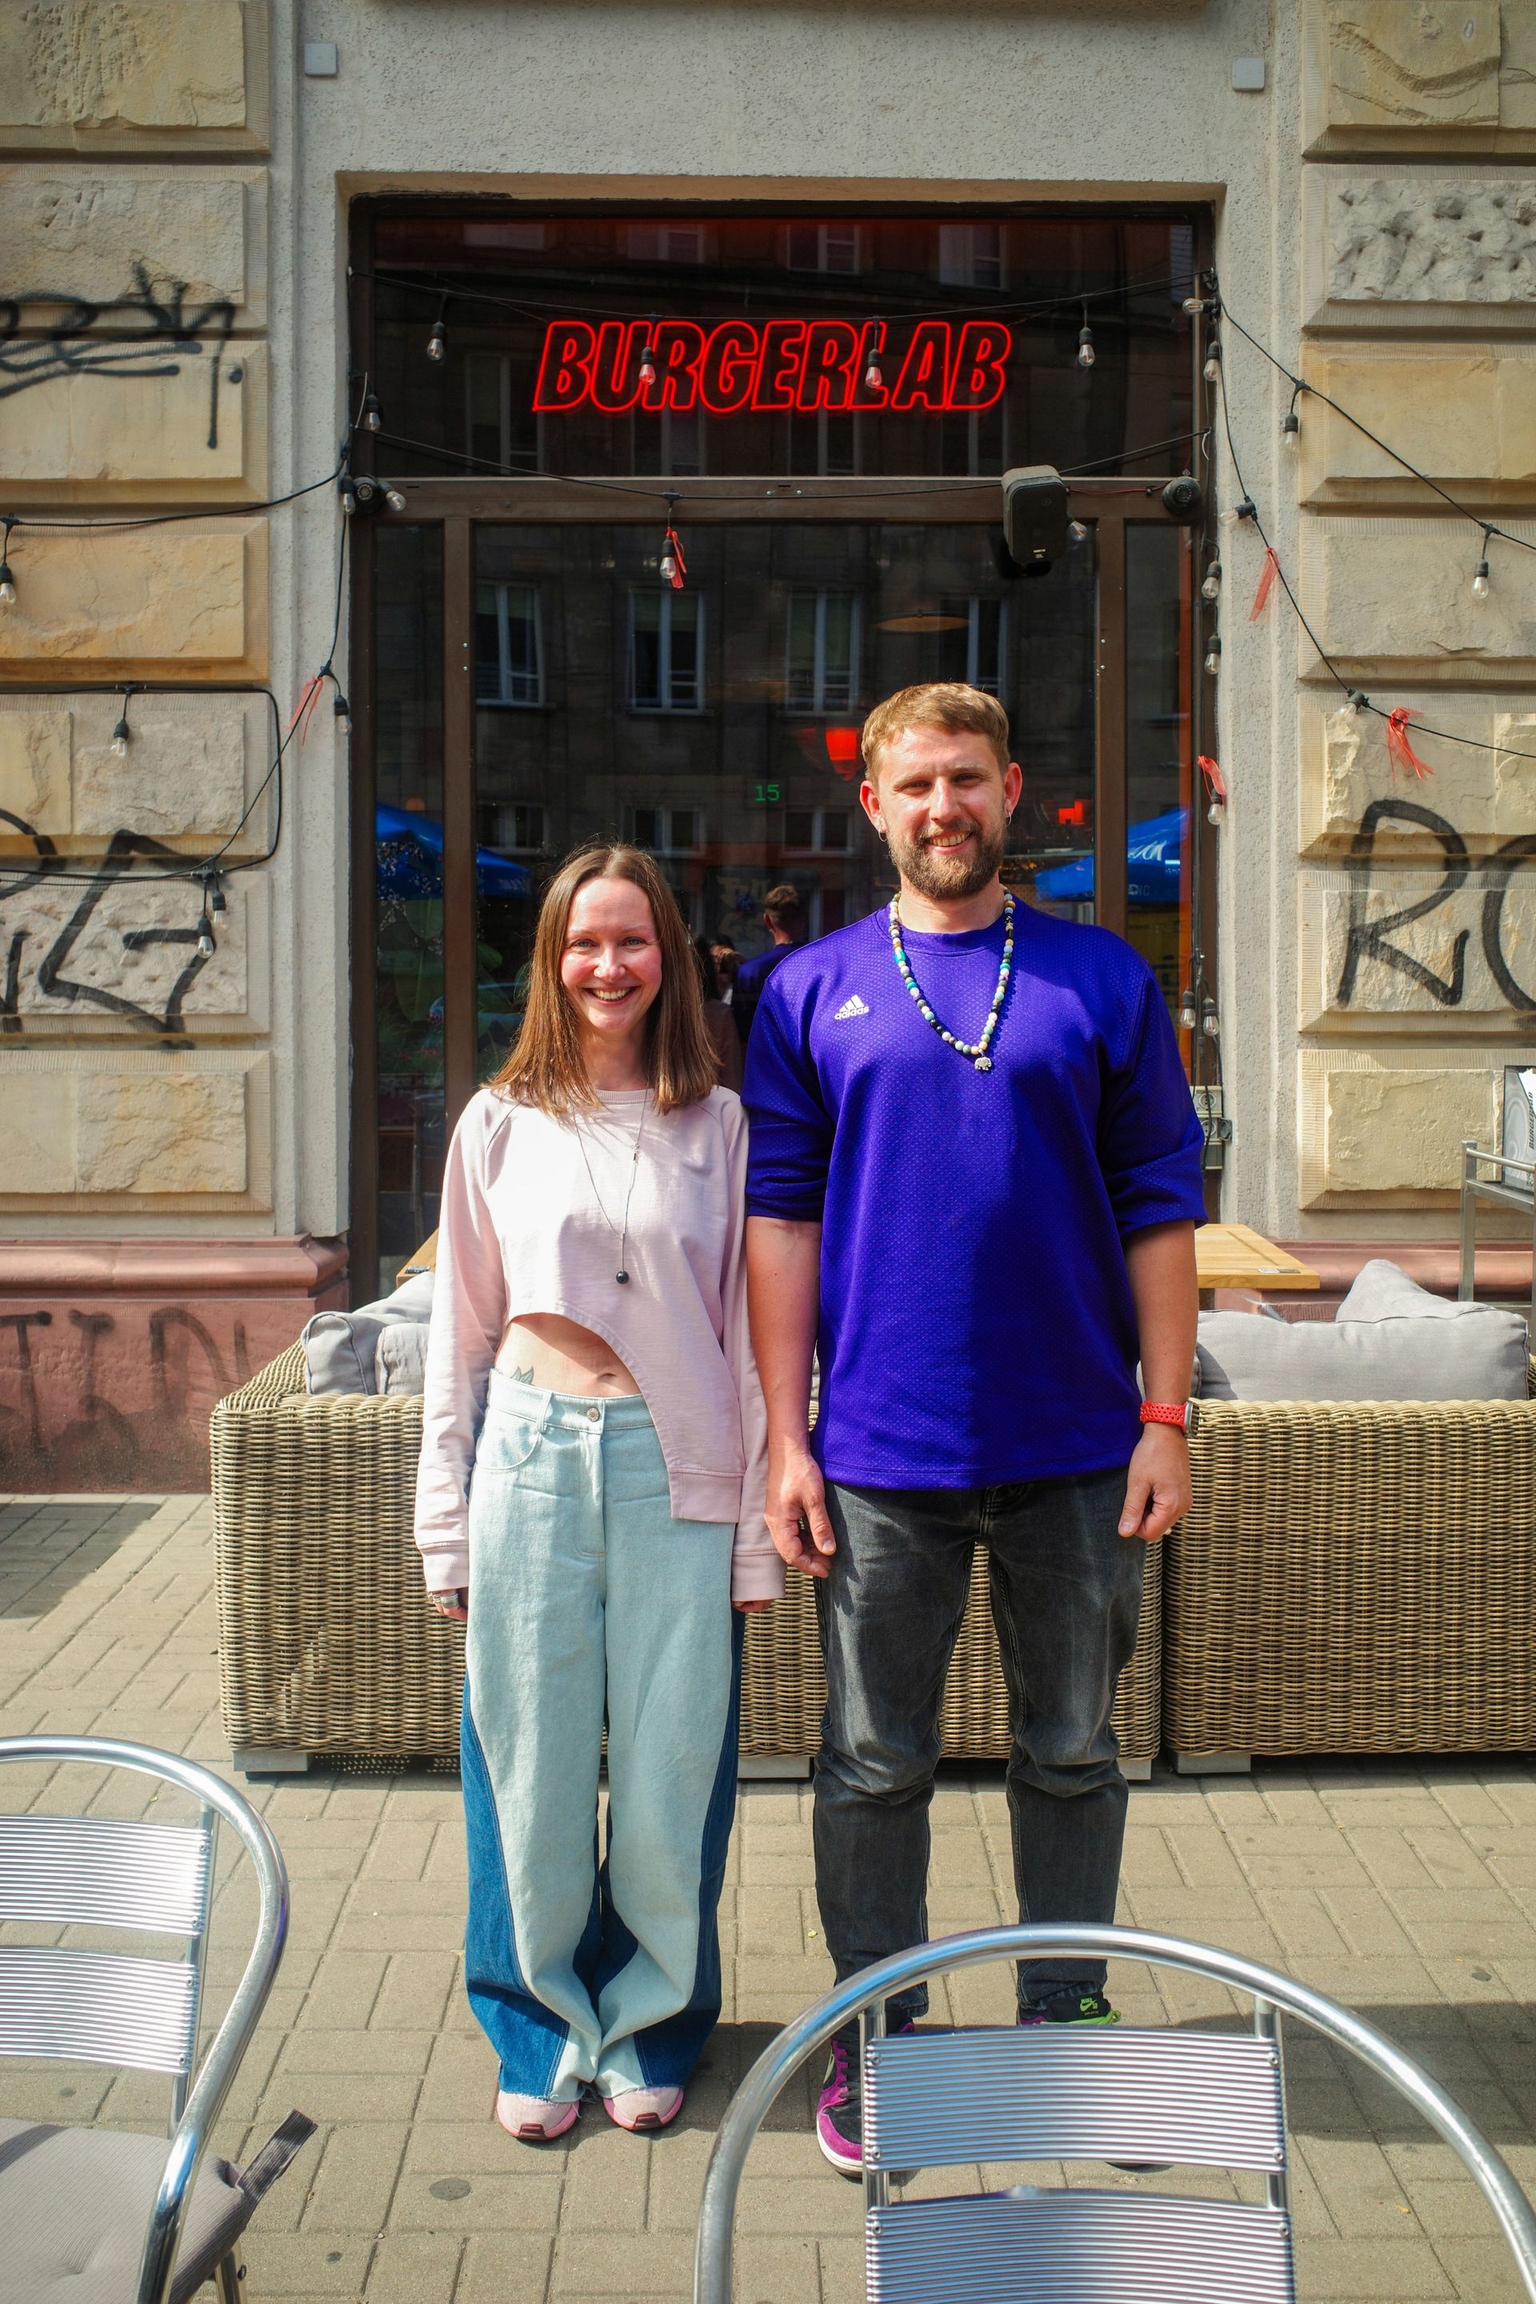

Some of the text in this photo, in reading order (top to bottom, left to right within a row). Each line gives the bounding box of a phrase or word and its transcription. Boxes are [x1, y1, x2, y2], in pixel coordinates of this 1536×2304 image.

[532, 320, 1011, 412] BURGERLAB
[756, 784, 780, 801] 15
[834, 1006, 870, 1020] adidas
